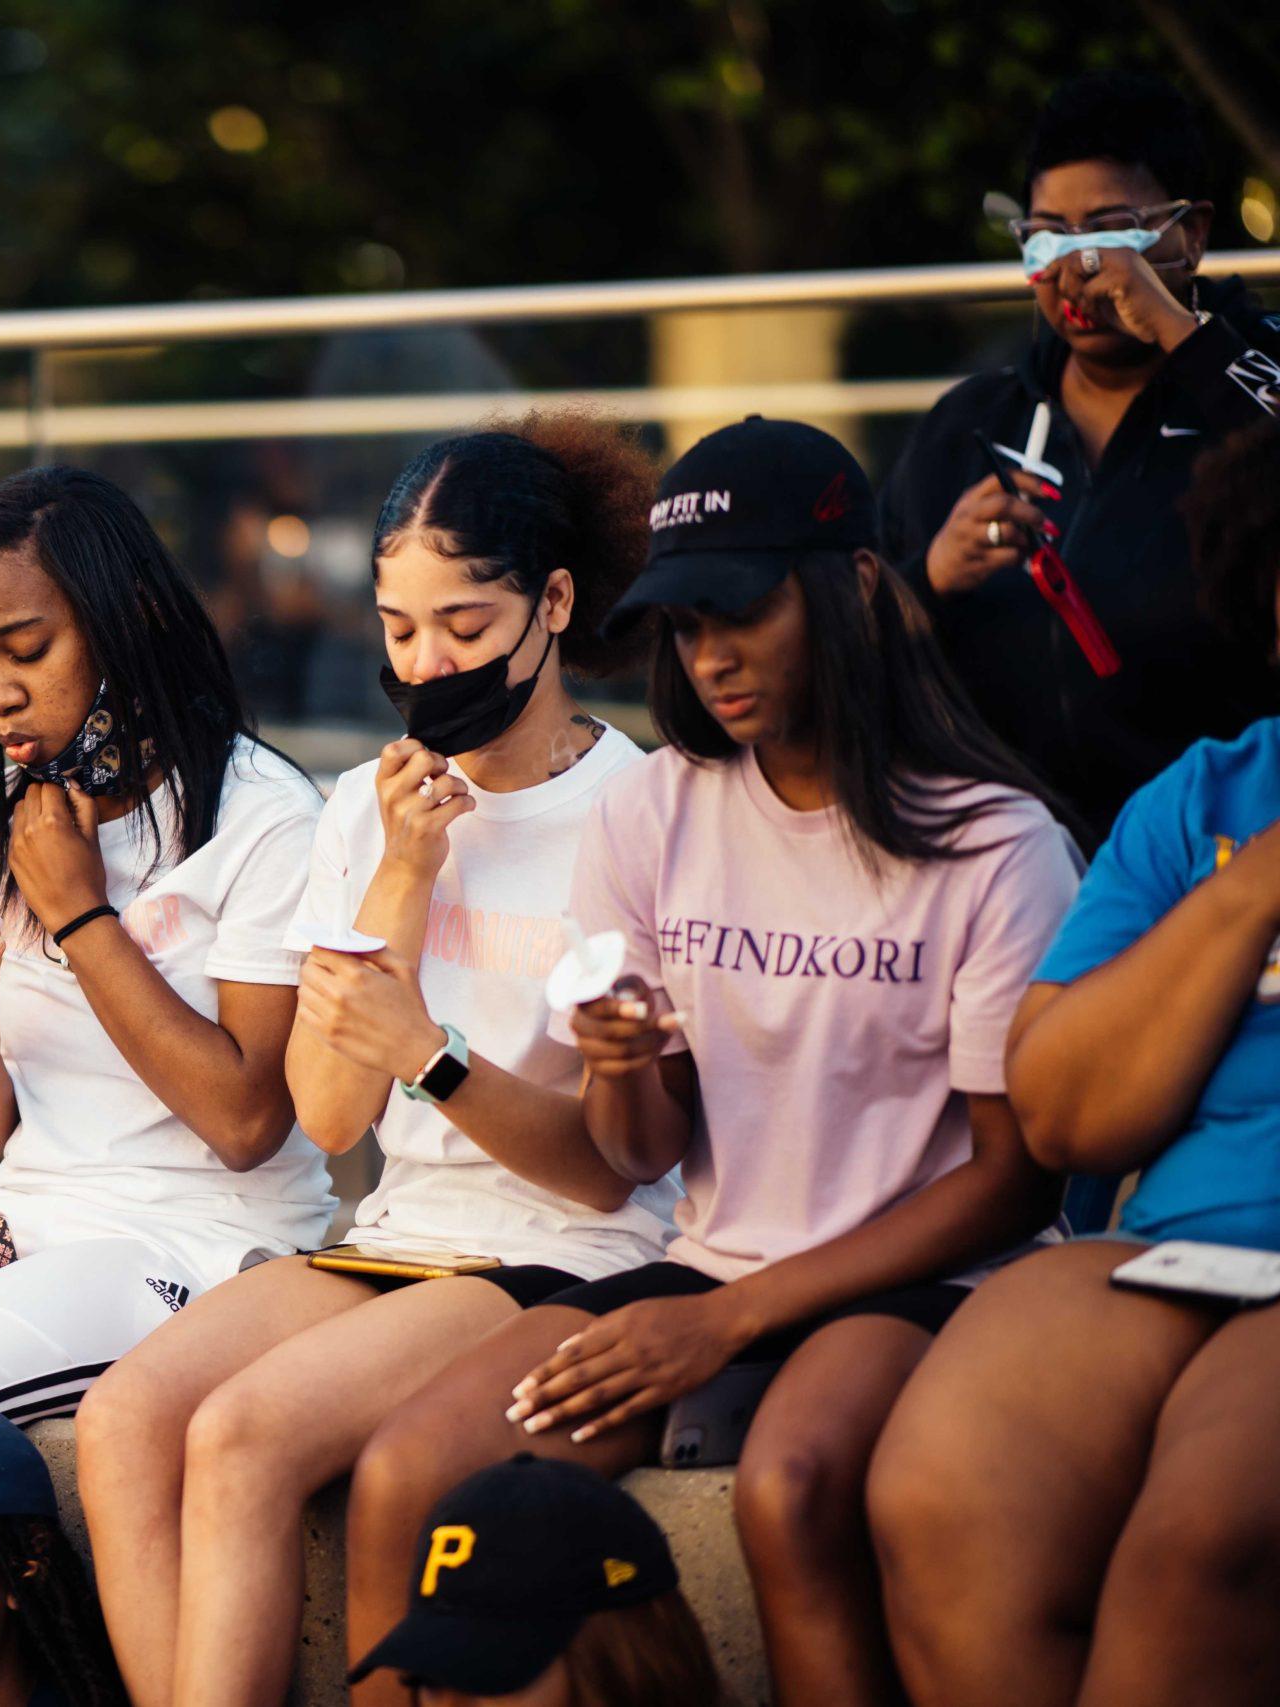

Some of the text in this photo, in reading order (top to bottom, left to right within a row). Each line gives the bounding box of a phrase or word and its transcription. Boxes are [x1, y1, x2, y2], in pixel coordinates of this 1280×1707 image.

[672, 492, 702, 515] FIT
[705, 490, 731, 512] IN
[659, 918, 926, 983] #FINDKORI
[146, 1278, 180, 1312] adida
[420, 1525, 477, 1598] P
